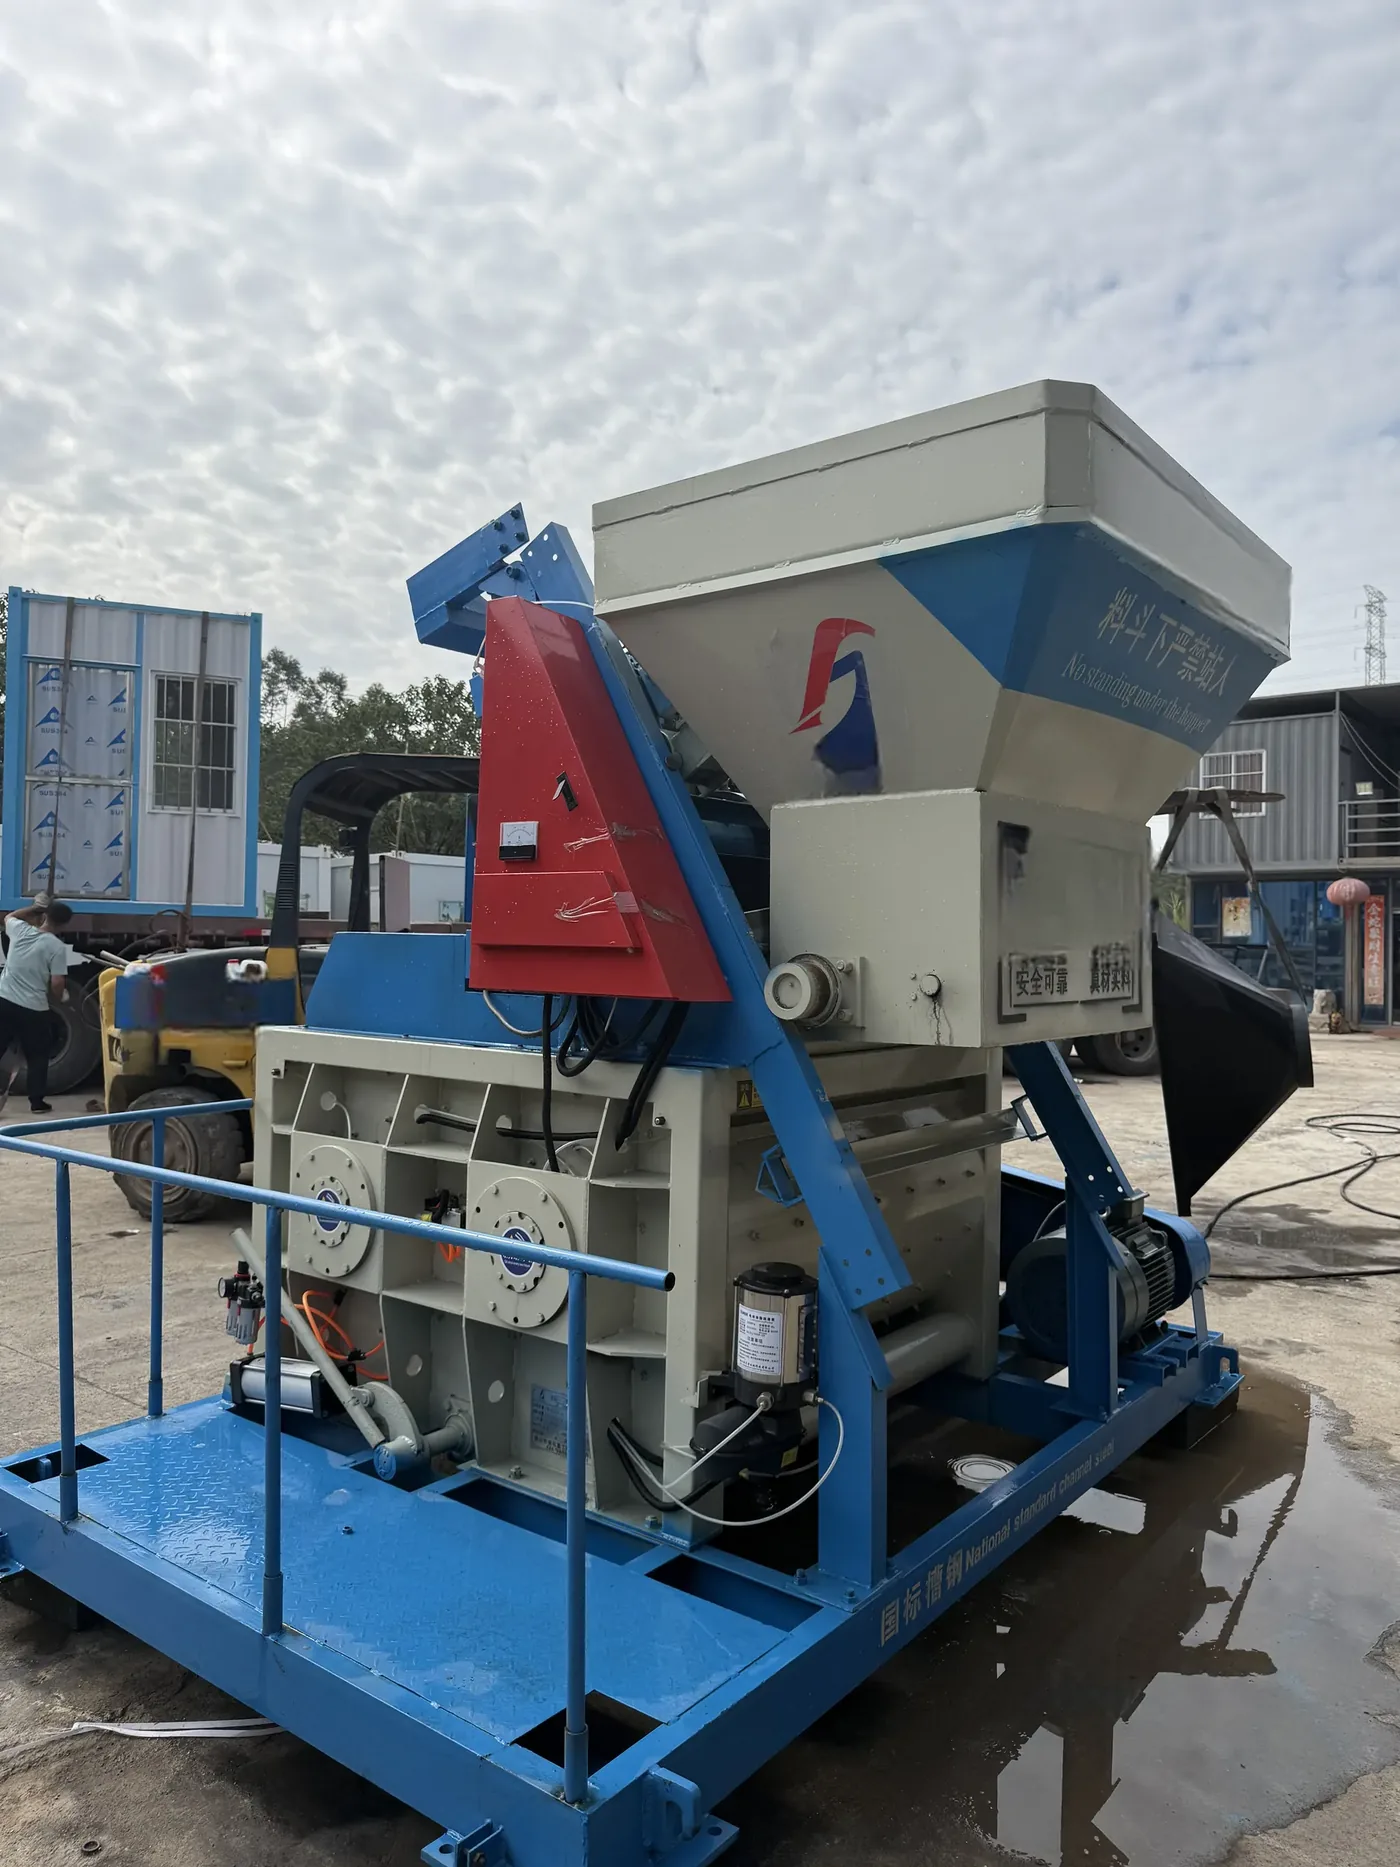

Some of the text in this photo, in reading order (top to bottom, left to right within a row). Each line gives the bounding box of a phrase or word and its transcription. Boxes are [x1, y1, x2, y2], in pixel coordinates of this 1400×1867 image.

[1097, 586, 1239, 696] 料斗下严禁站人
[1061, 651, 1212, 734] No standing under the hopper
[1016, 967, 1068, 997] 安全可靠
[965, 1518, 1011, 1571] National
[1013, 1484, 1056, 1531] standard
[1059, 1454, 1092, 1494] channel
